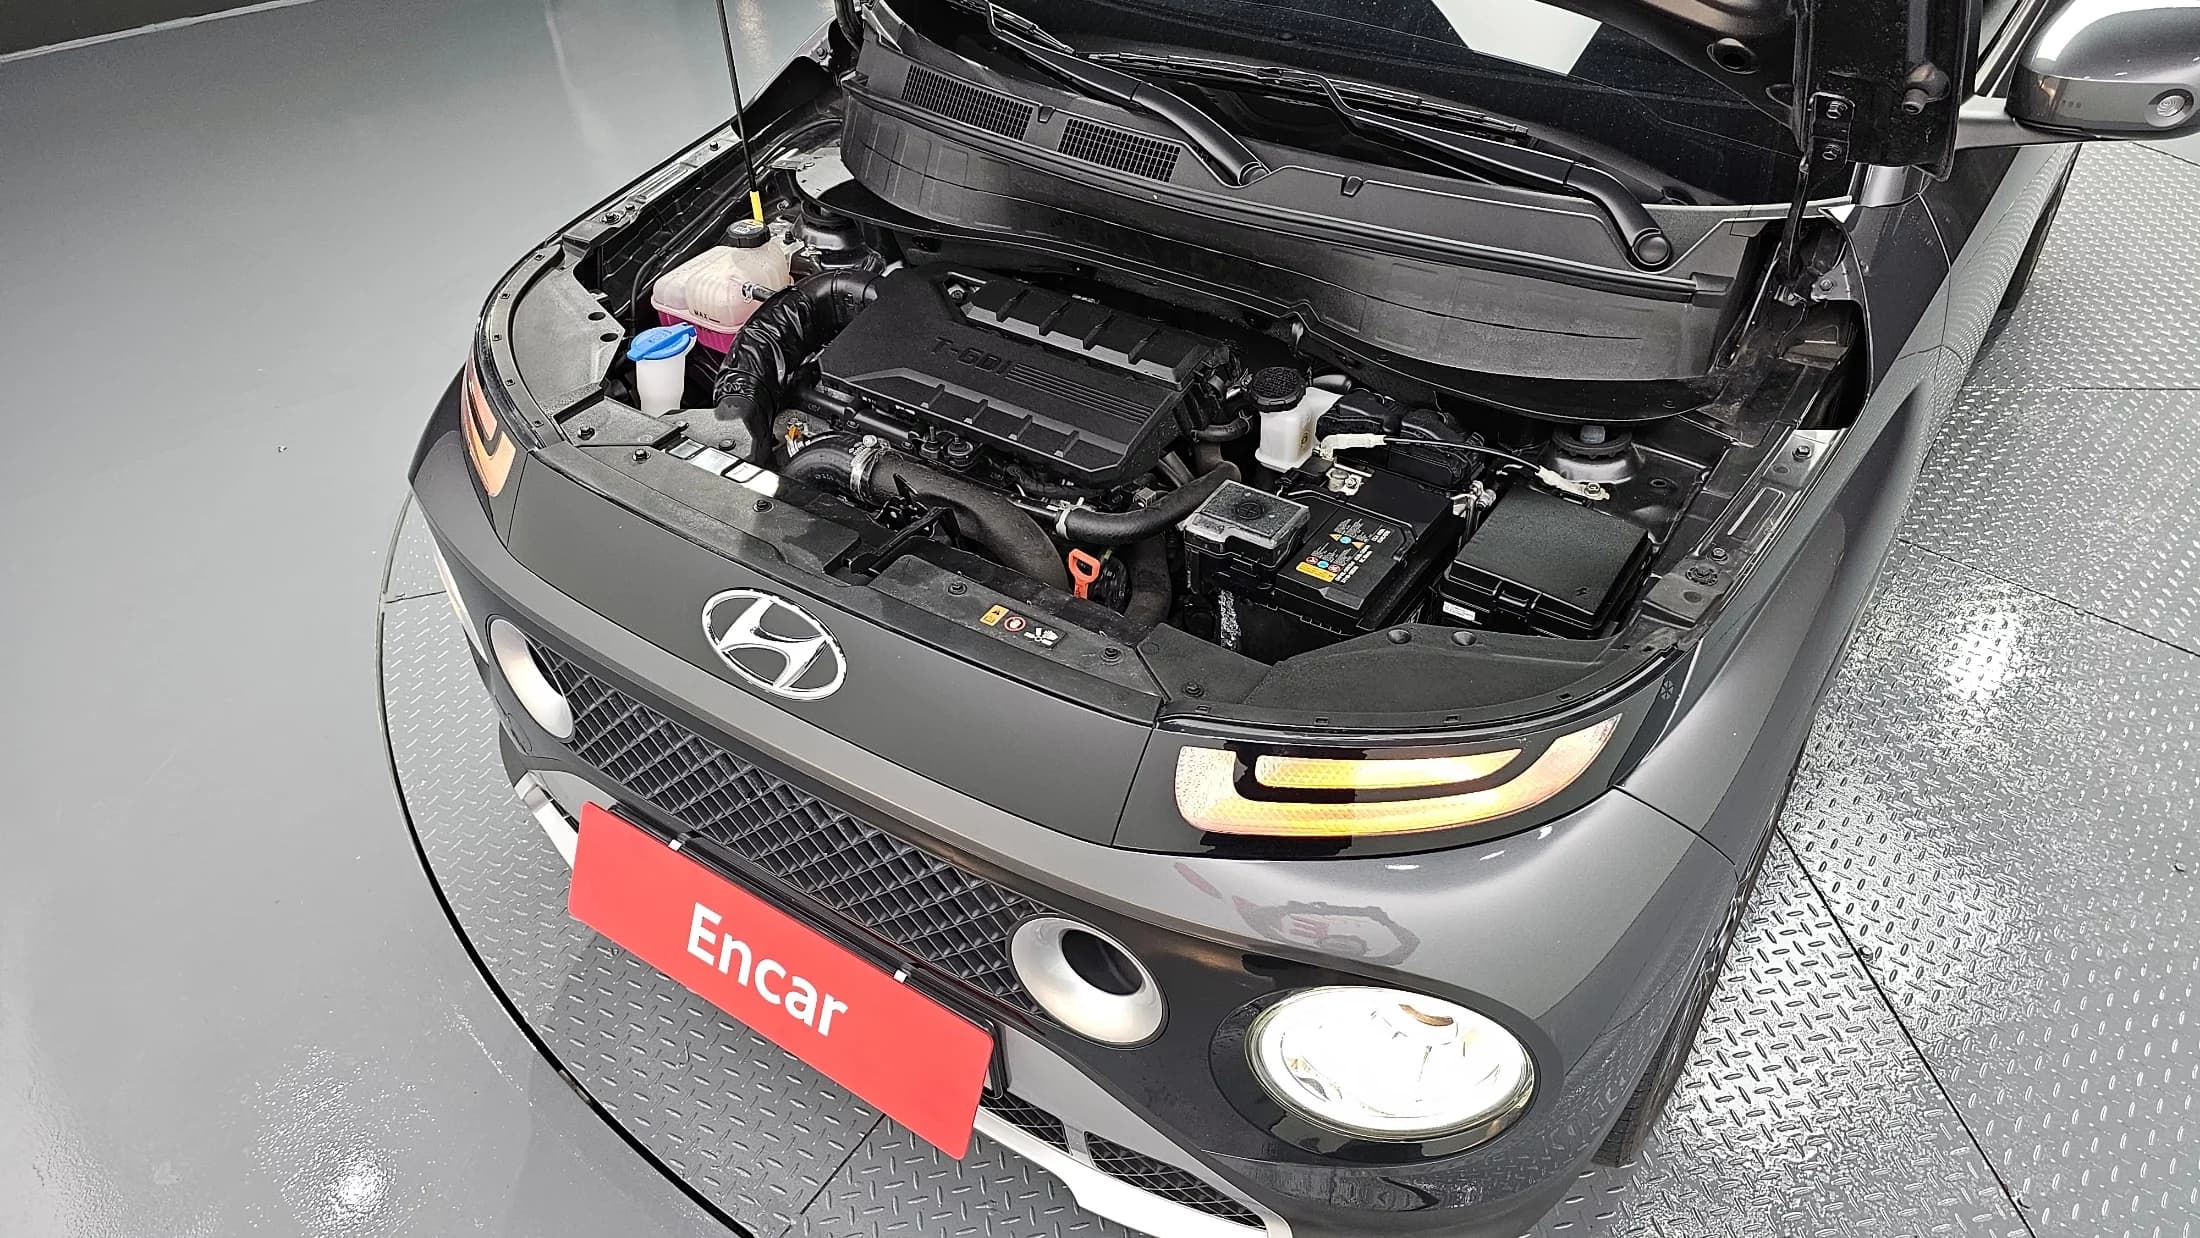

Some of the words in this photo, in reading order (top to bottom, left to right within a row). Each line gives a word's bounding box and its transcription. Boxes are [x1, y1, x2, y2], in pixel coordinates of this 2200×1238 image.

[693, 309, 708, 319] MAX
[930, 337, 1012, 376] T-GDI
[687, 902, 849, 1037] Encar
